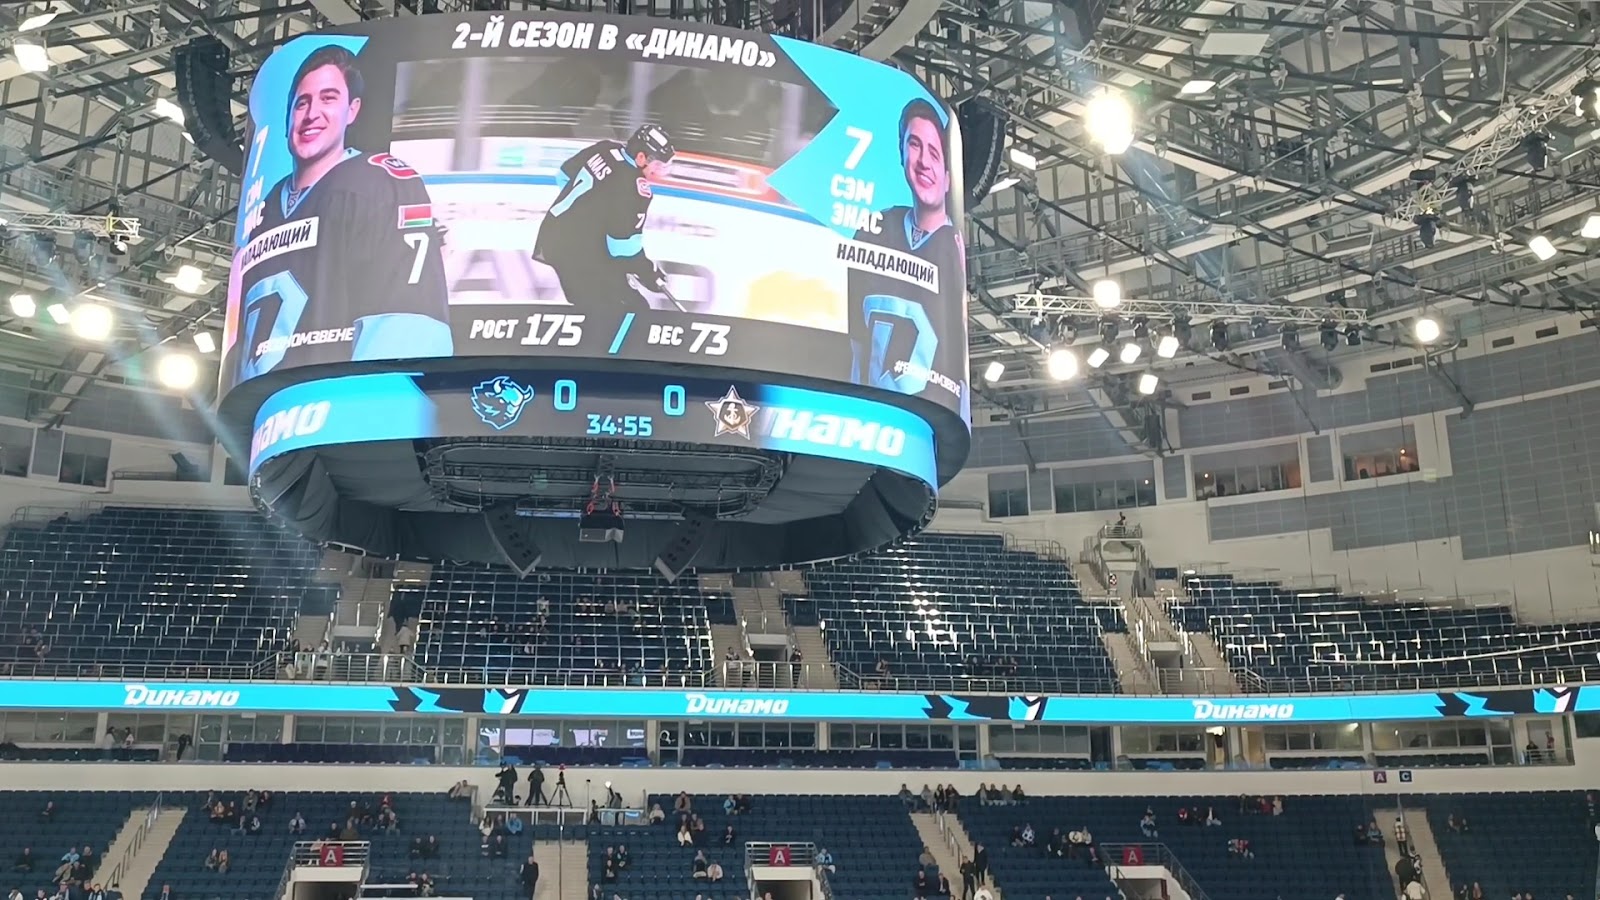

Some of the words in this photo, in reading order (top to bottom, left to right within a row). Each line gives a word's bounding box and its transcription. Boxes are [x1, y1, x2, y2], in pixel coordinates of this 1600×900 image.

[452, 15, 504, 49] 2-Й
[509, 21, 594, 49] СЕЗОН
[598, 24, 618, 50] В
[625, 28, 776, 68] «ДИНАМО»
[844, 126, 873, 170] 7
[830, 174, 875, 205] СЭМ
[831, 202, 884, 234] ЭНАС
[403, 232, 430, 284] 7
[836, 243, 935, 284] НАПАДАЮЩИЙ
[256, 327, 356, 356] #ВОМЗВЕНЕ
[469, 320, 518, 339] РОСТ
[521, 314, 585, 346] 175
[648, 325, 684, 346] ВЕС
[688, 322, 731, 355] 73
[554, 379, 577, 411] 0
[663, 385, 686, 416] 0
[586, 414, 653, 437] 34:55
[324, 849, 337, 863] A
[774, 850, 786, 864] A
[1127, 850, 1139, 863] A
